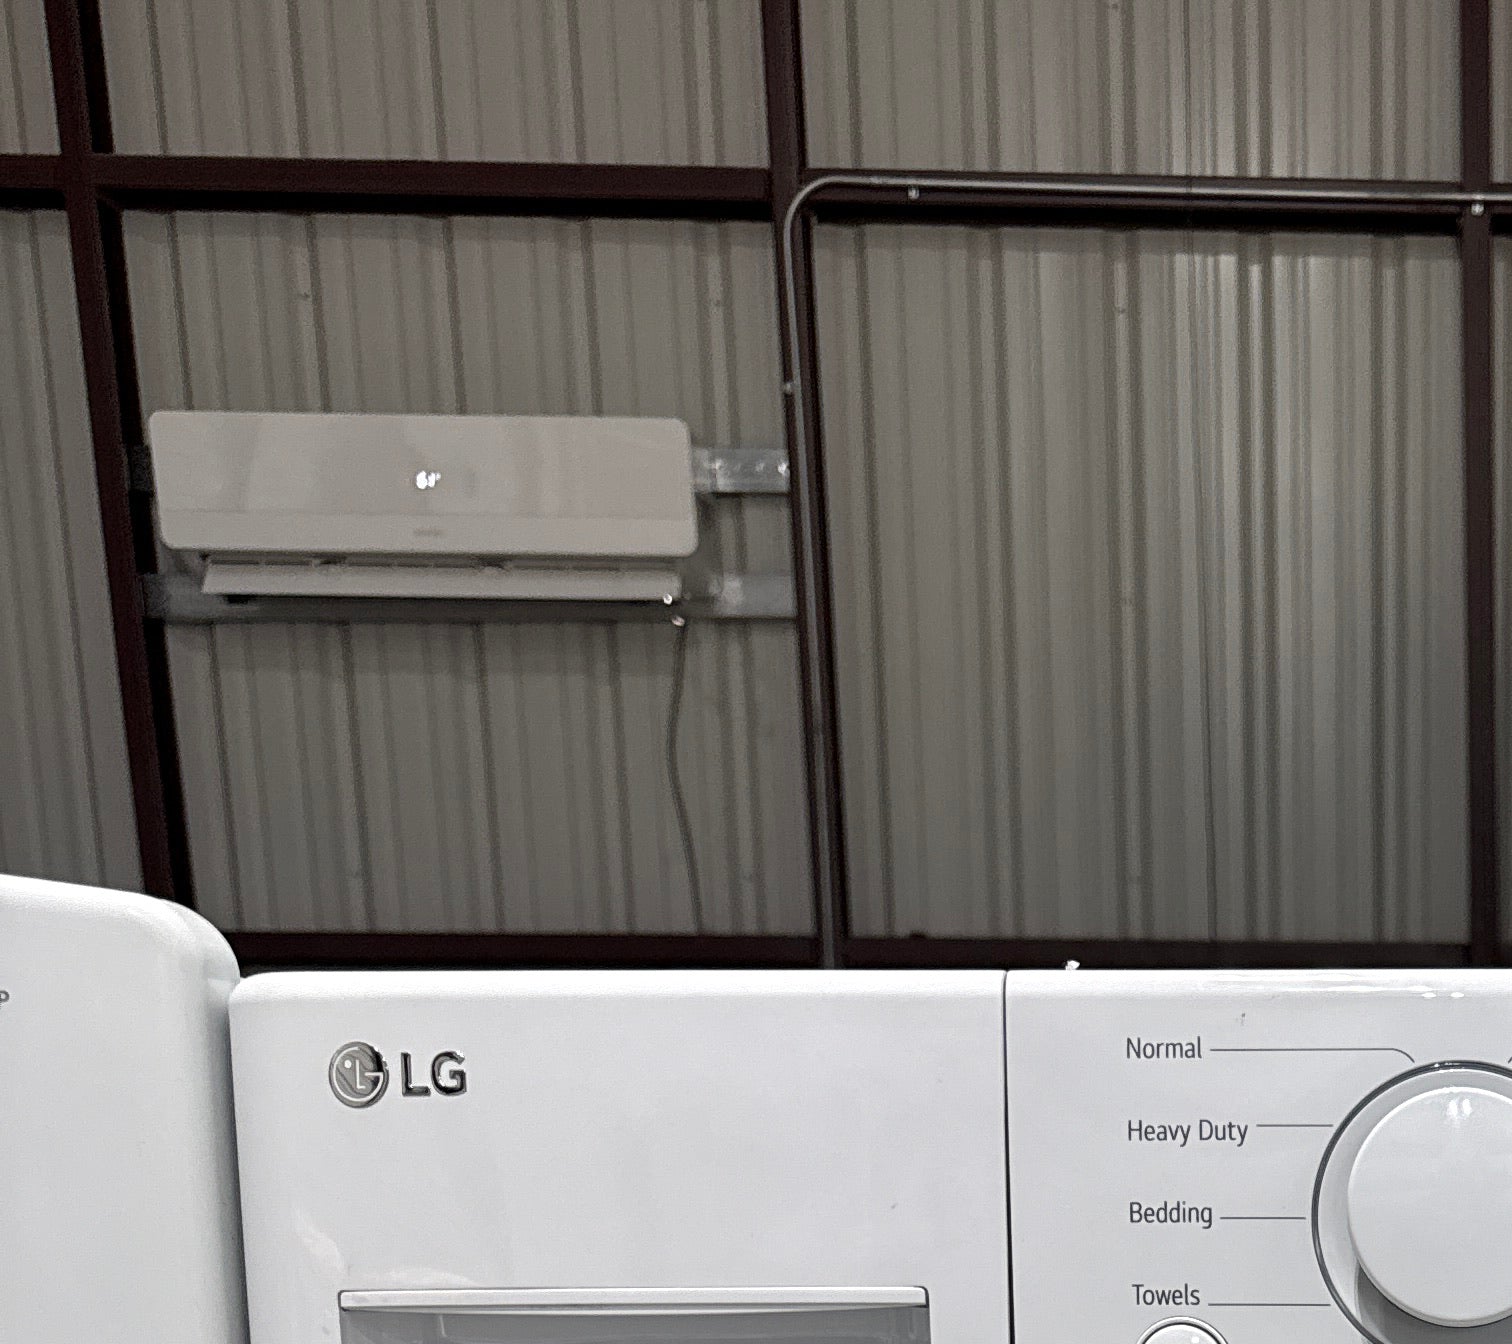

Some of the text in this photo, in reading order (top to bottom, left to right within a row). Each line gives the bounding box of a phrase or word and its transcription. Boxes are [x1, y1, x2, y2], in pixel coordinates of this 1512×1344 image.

[1126, 1036, 1202, 1059] Normal
[401, 1051, 468, 1097] LG
[1128, 1119, 1248, 1147] Heavy Duty
[1129, 1200, 1213, 1229] Bedding
[1131, 1283, 1201, 1306] Towels
